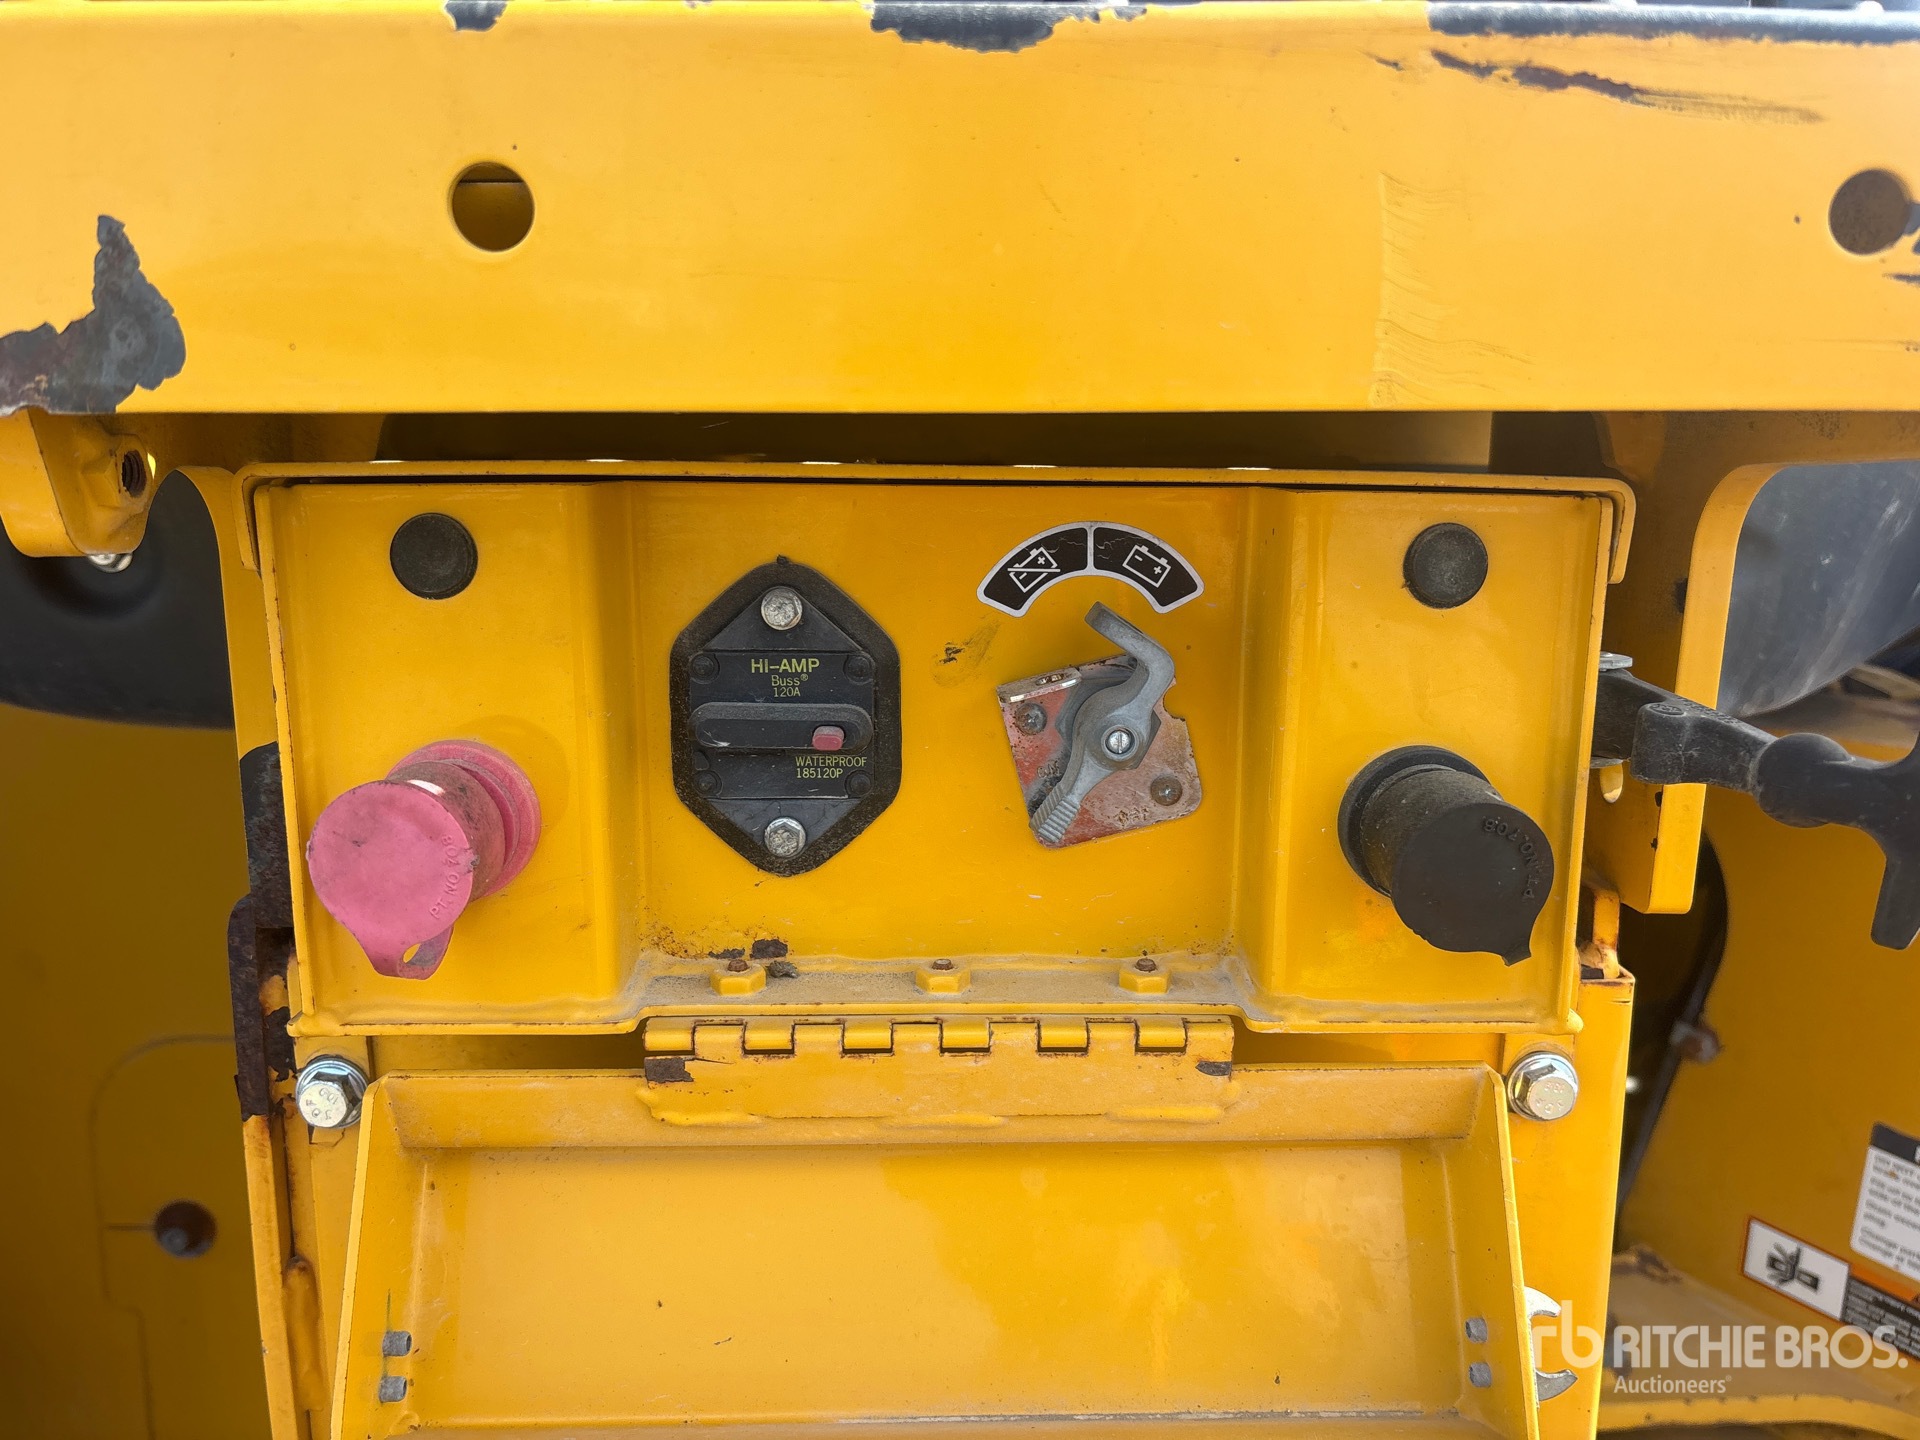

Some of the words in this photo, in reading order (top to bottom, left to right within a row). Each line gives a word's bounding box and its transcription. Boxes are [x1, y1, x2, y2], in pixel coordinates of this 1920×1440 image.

[751, 658, 820, 674] HI-AMP
[773, 687, 801, 697] 120A
[795, 756, 867, 767] WATERPROOF
[796, 768, 843, 778] 185120P
